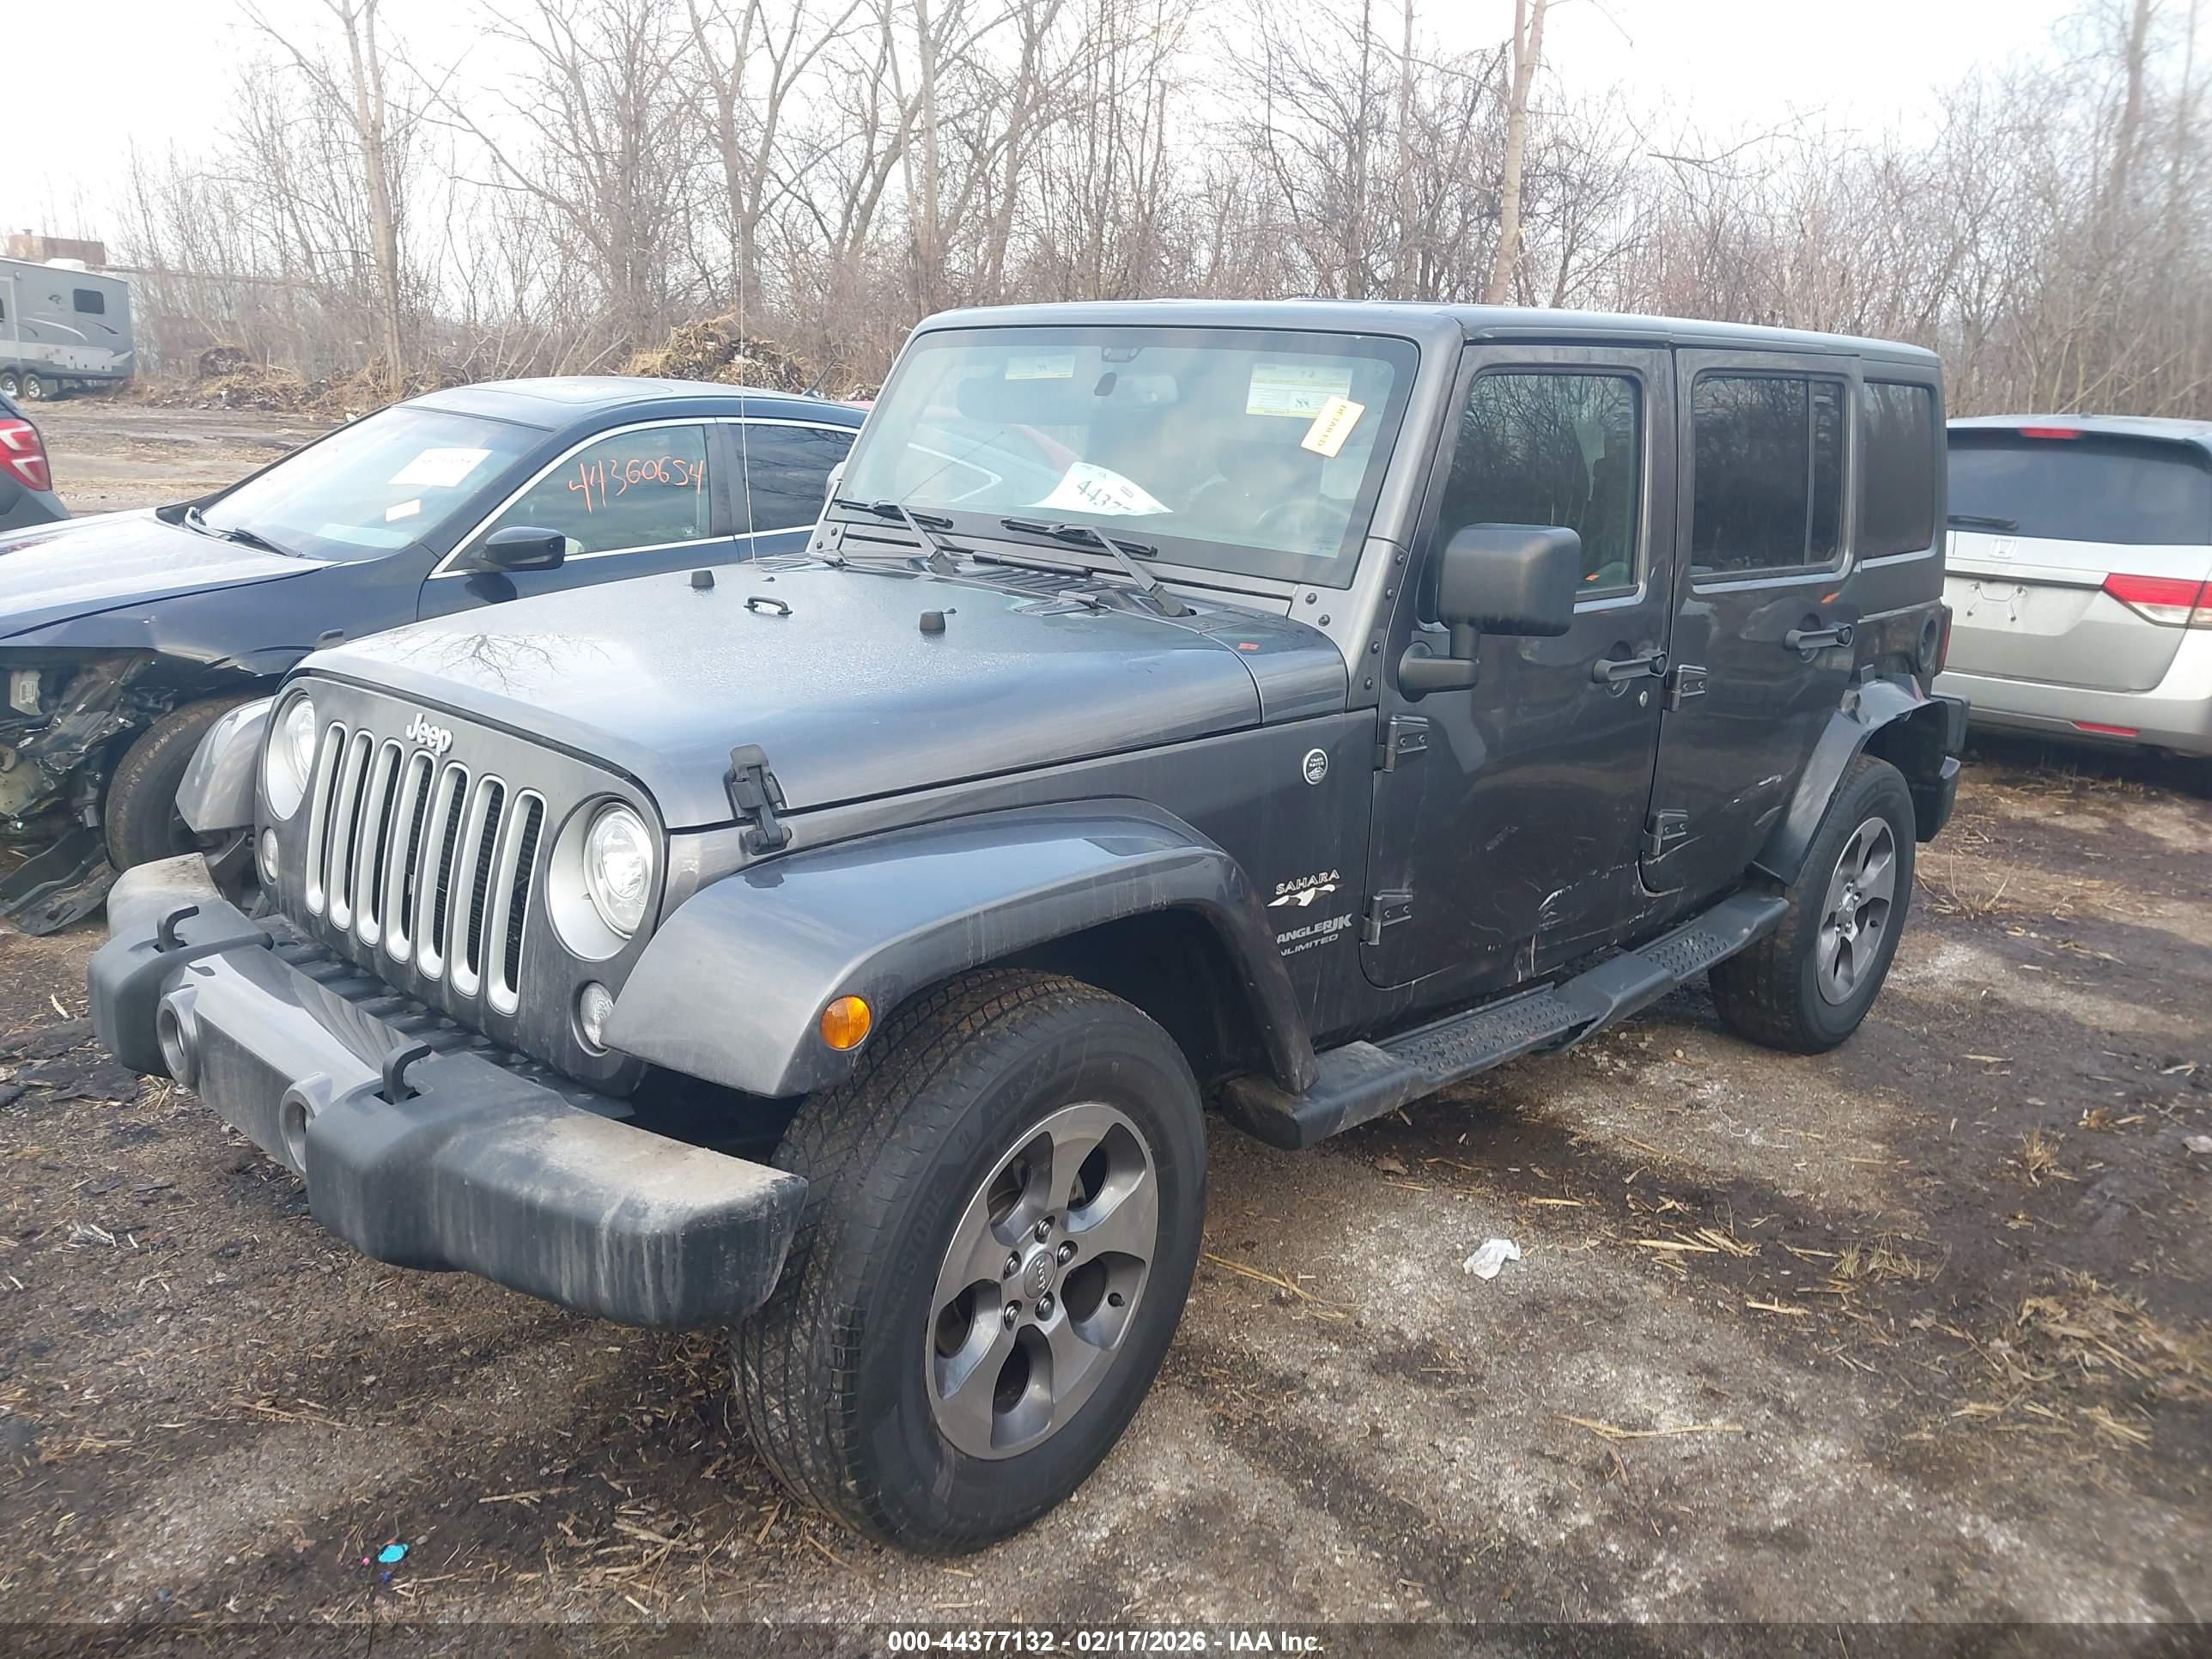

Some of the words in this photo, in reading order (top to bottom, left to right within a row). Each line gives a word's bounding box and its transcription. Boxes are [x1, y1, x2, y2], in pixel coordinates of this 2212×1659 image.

[1076, 479, 1133, 512] 4437
[405, 712, 453, 757] Jeep
[1275, 869, 1340, 895] SAHARA
